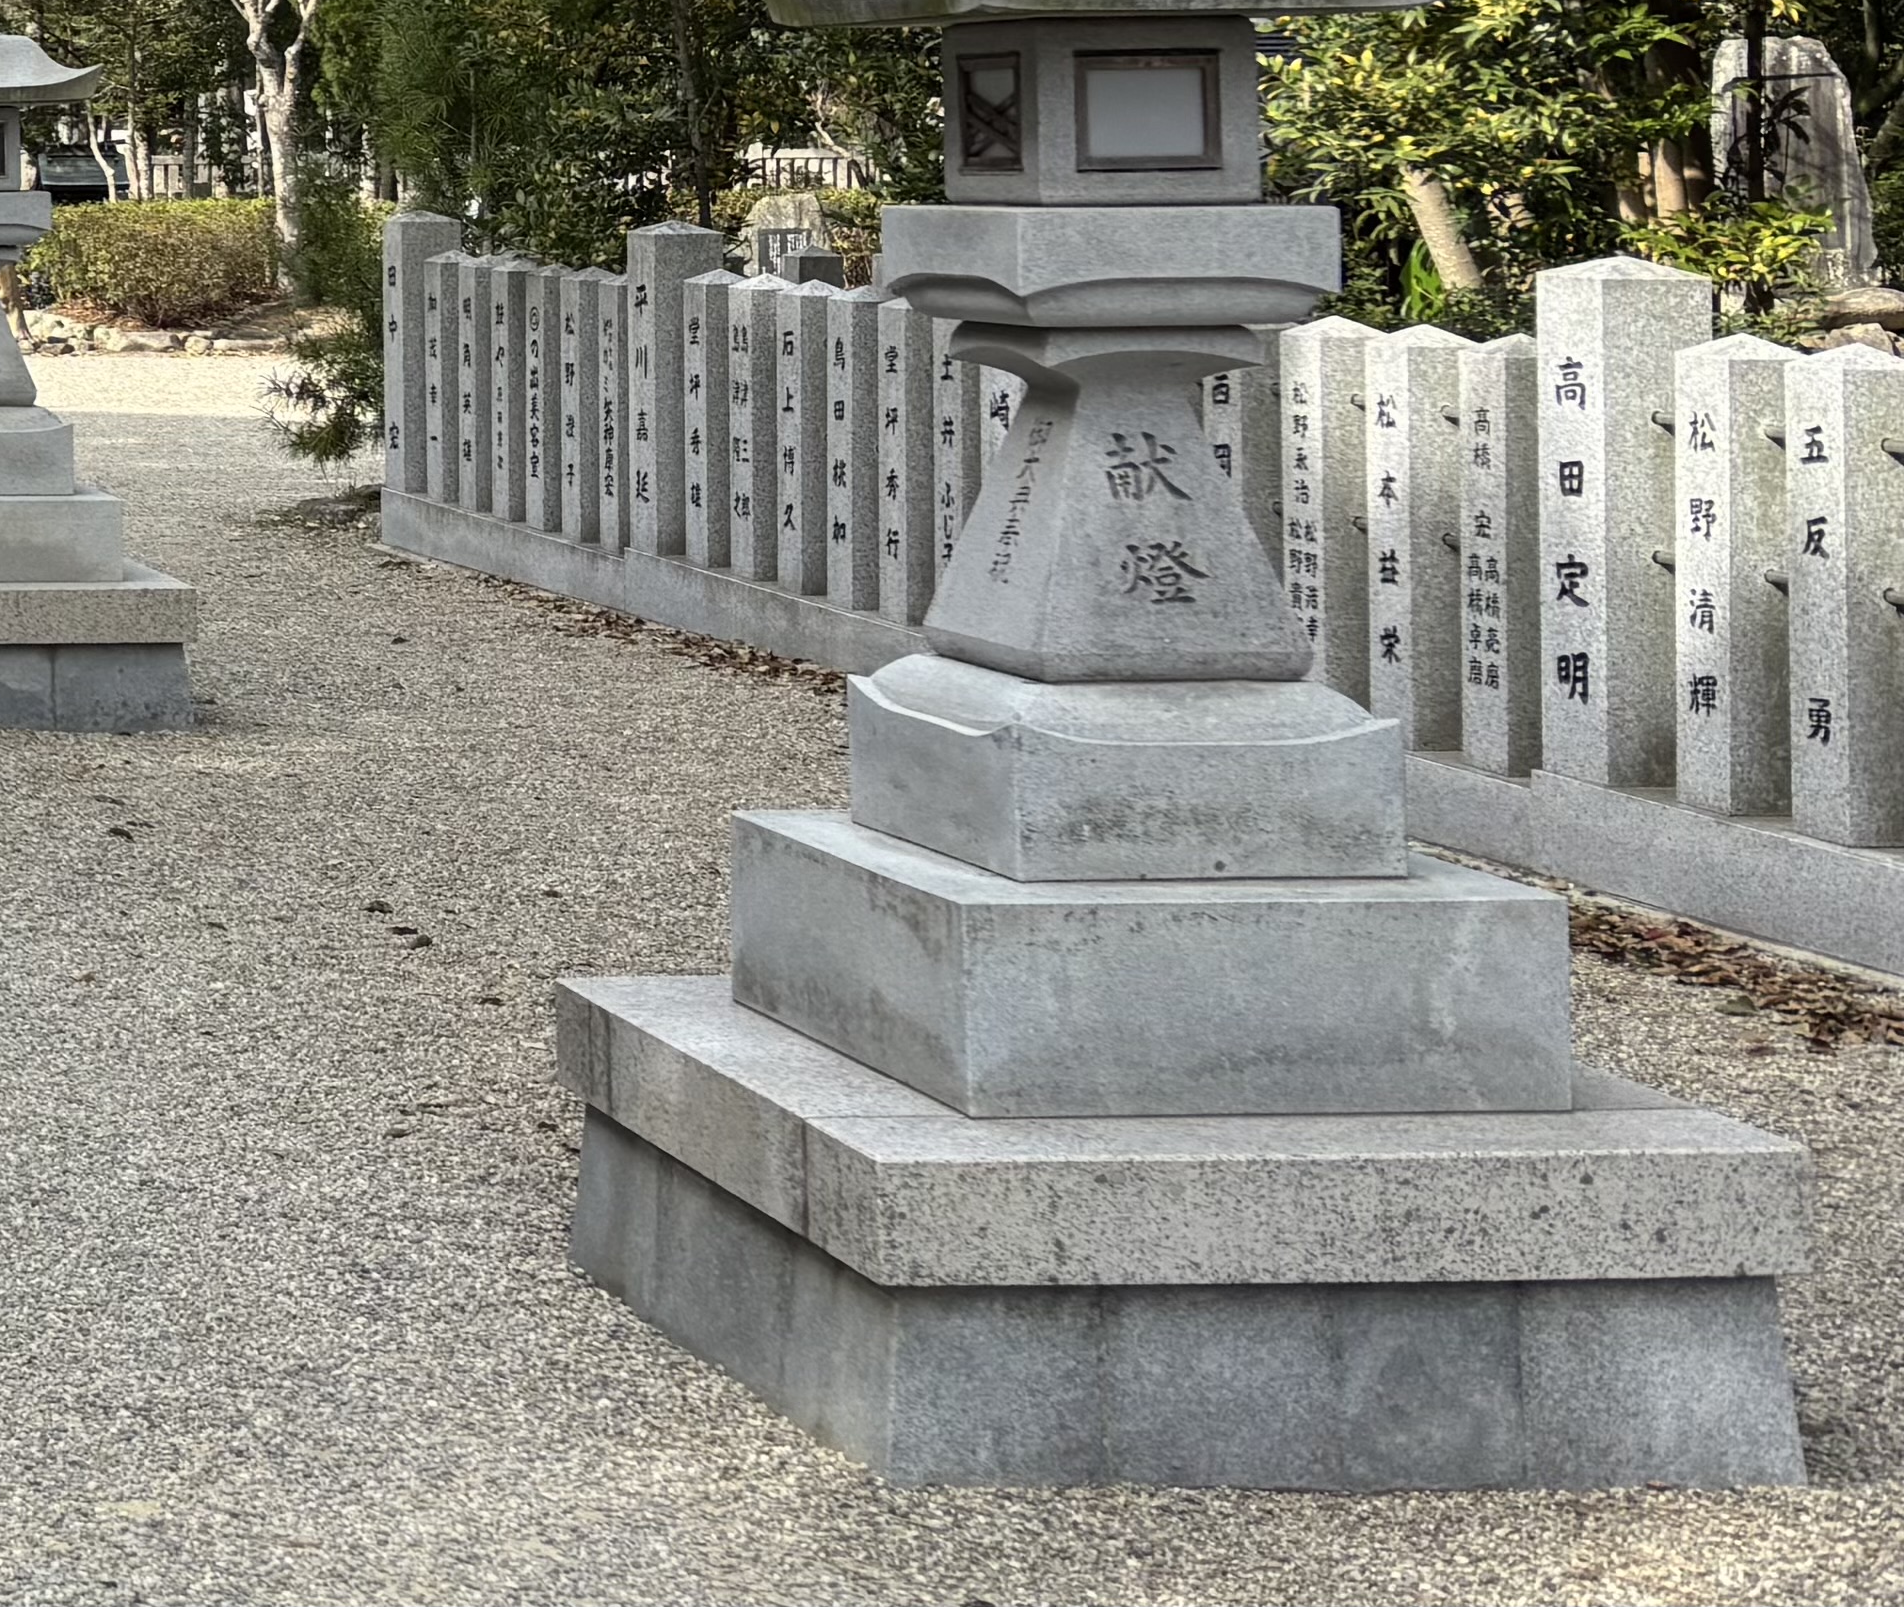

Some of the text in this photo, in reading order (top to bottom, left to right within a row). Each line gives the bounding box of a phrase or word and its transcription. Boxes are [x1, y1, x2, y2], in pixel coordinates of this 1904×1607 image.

[1103, 431, 1211, 605] 献燈
[1555, 356, 1590, 706] 高田定明
